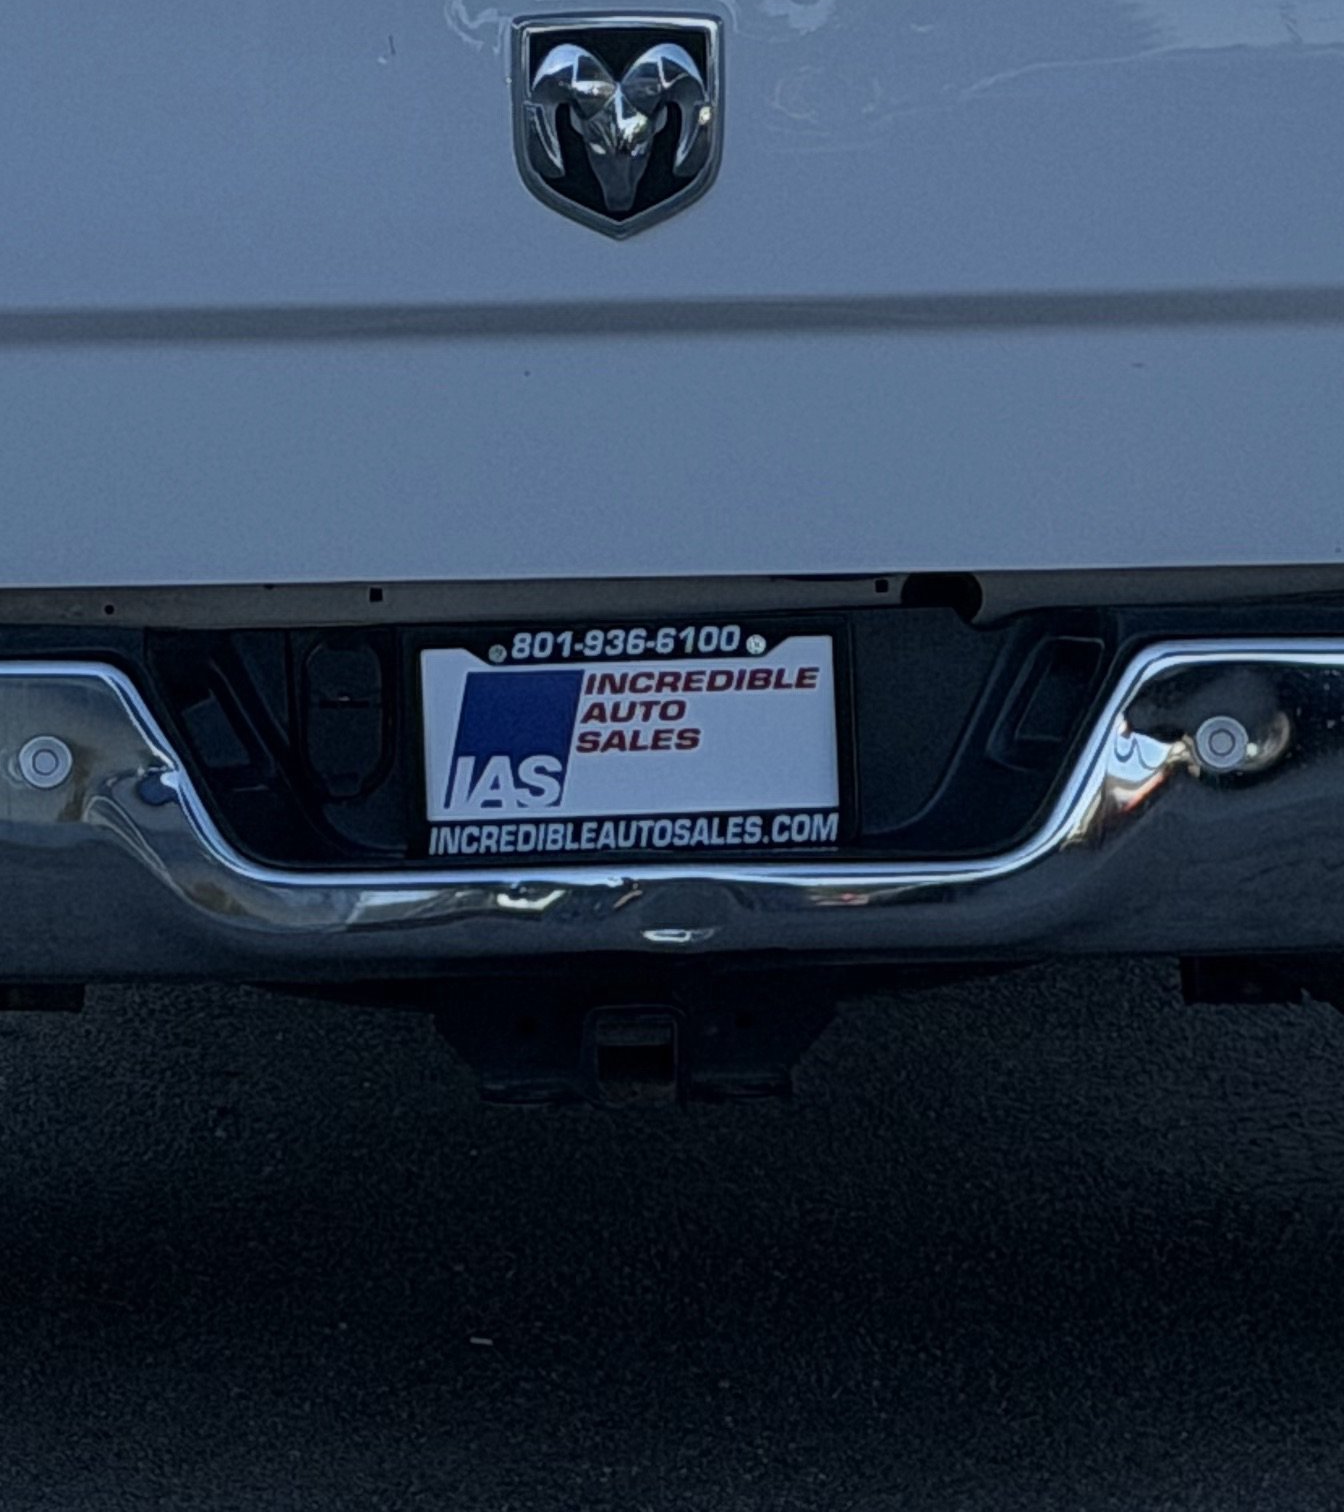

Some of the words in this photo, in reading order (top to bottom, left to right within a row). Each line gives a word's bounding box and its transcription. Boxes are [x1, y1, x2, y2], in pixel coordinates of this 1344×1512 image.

[511, 624, 742, 660] 801-936-6100
[585, 666, 820, 695] INCREDIBLE
[580, 700, 687, 724] AUTO
[575, 728, 702, 754] SALES
[452, 754, 563, 809] IAS
[429, 812, 840, 856] INCREDIBLEAUTOSALES.COM
